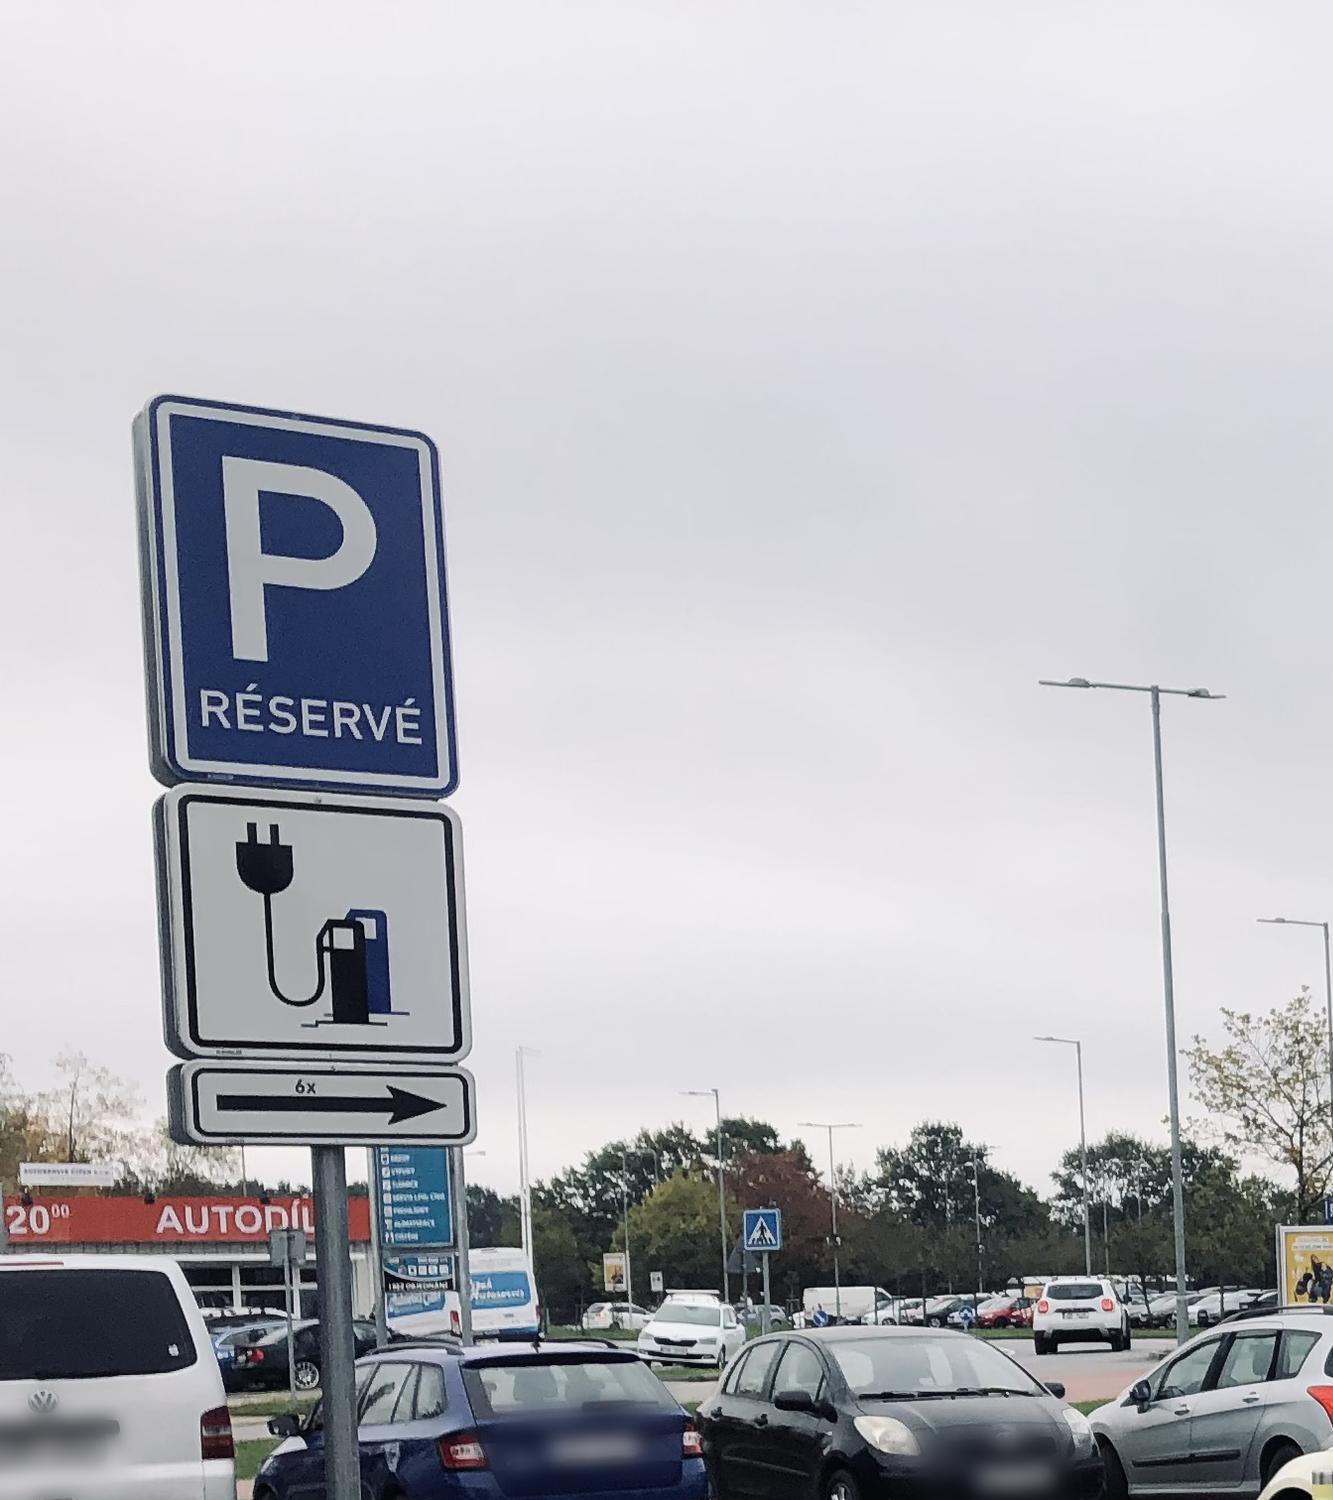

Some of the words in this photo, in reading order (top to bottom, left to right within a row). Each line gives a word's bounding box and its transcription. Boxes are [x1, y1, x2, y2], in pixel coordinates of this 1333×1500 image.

[221, 454, 378, 662] P
[199, 684, 423, 745] RÉSERVÉ
[295, 1079, 316, 1094] 6x
[156, 1193, 316, 1234] AUTODÍL
